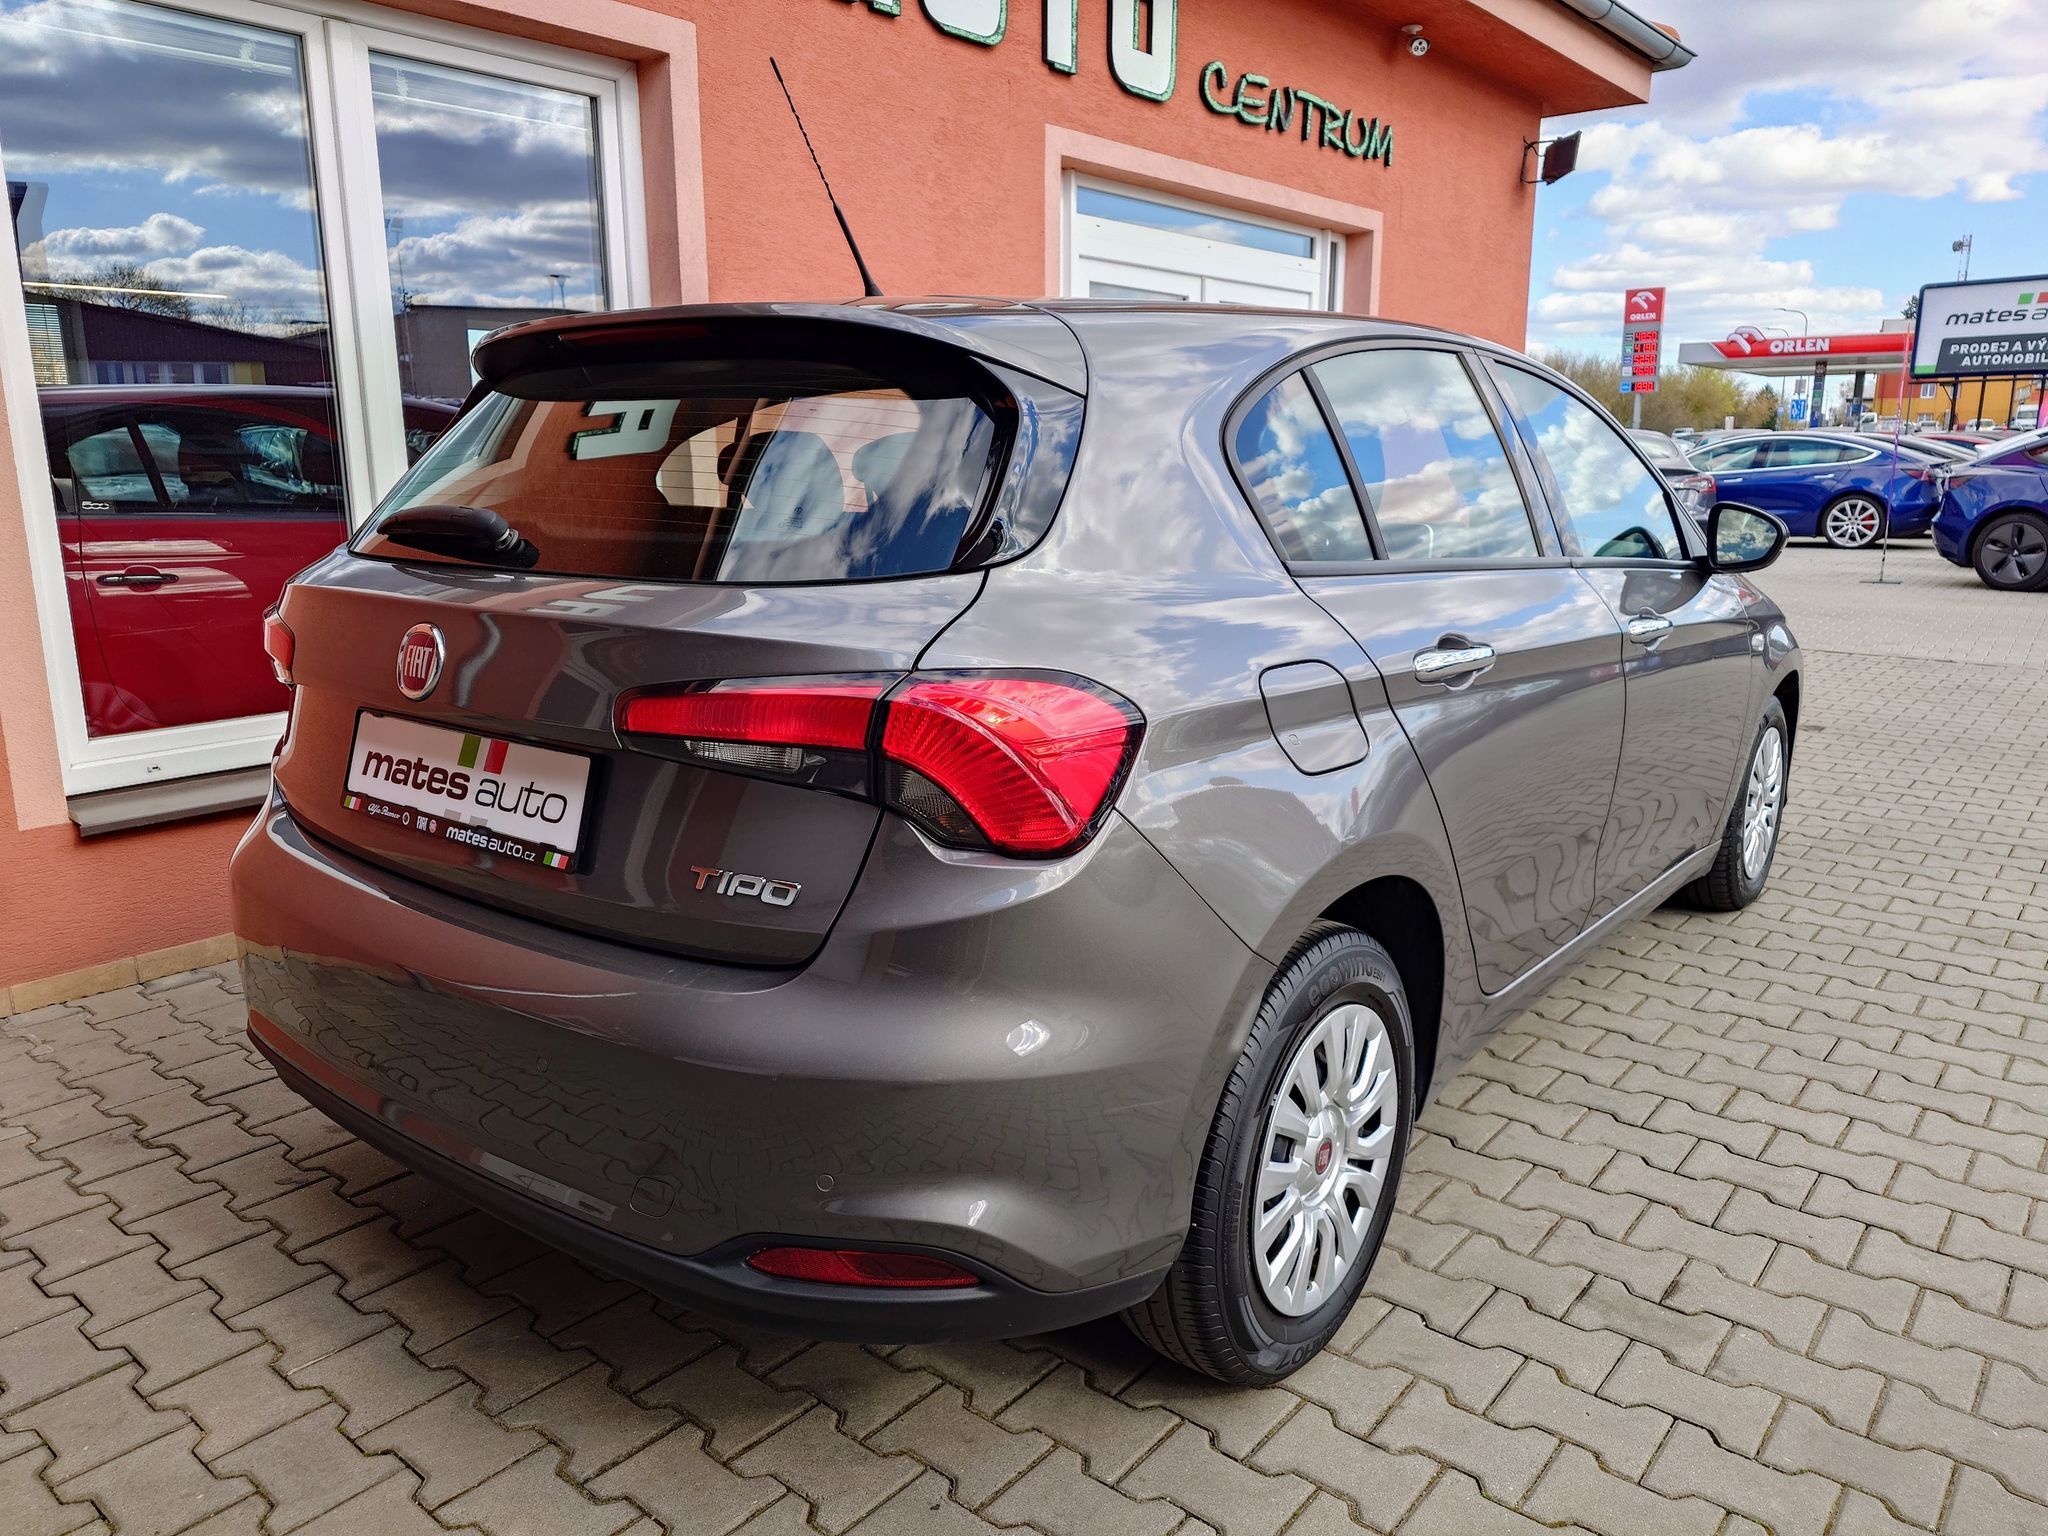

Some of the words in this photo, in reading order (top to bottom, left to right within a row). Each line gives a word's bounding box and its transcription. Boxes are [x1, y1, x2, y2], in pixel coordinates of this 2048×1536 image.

[1200, 60, 1394, 168] CENTRUM
[1630, 312, 1656, 321] ORLEN
[1945, 308, 2029, 325] mates
[1769, 338, 1830, 354] ORLEN
[1950, 341, 2010, 355] PRODEJ
[2012, 341, 2022, 352] A
[2027, 337, 2048, 352] VÝ
[404, 644, 433, 679] FIAT
[361, 750, 471, 801] mates
[475, 778, 568, 824] auto
[446, 825, 536, 862] matesauto.cz
[690, 865, 801, 907] TIPO
